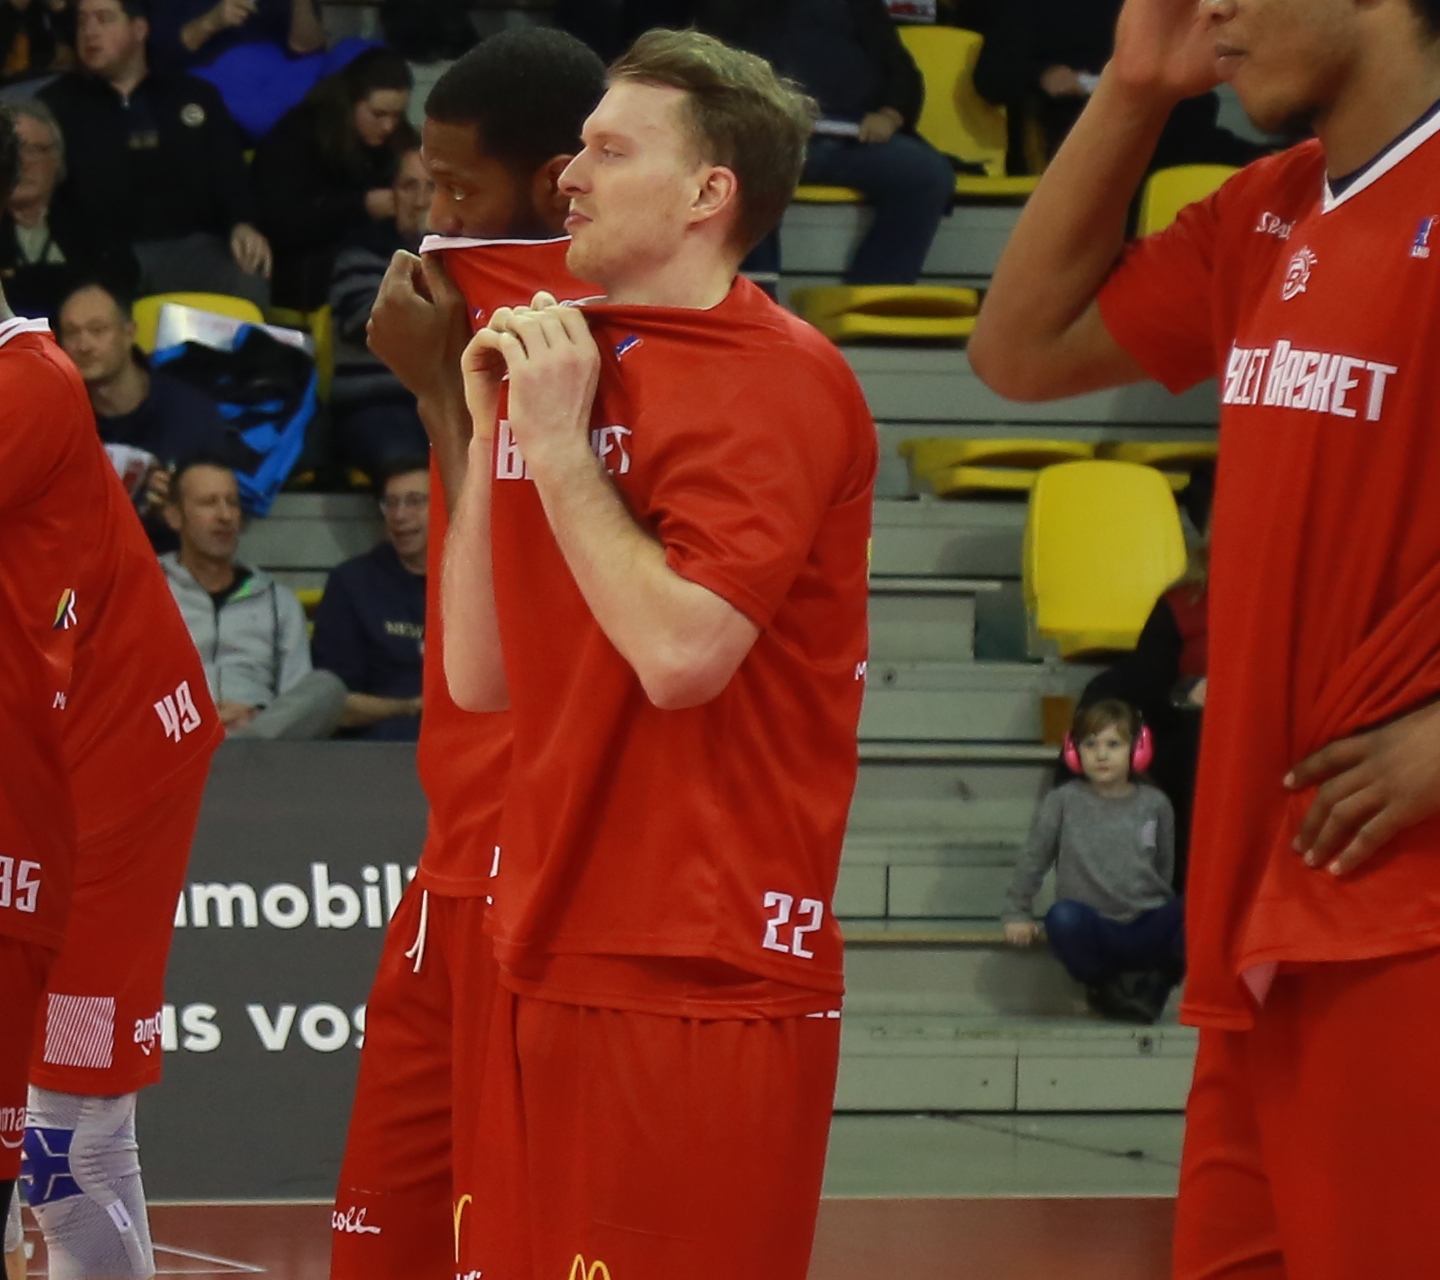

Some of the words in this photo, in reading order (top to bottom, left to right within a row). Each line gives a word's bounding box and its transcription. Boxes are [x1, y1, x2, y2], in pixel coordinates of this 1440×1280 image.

[1262, 338, 1399, 422] BASKET
[152, 680, 203, 742] 49
[762, 890, 824, 960] 22
